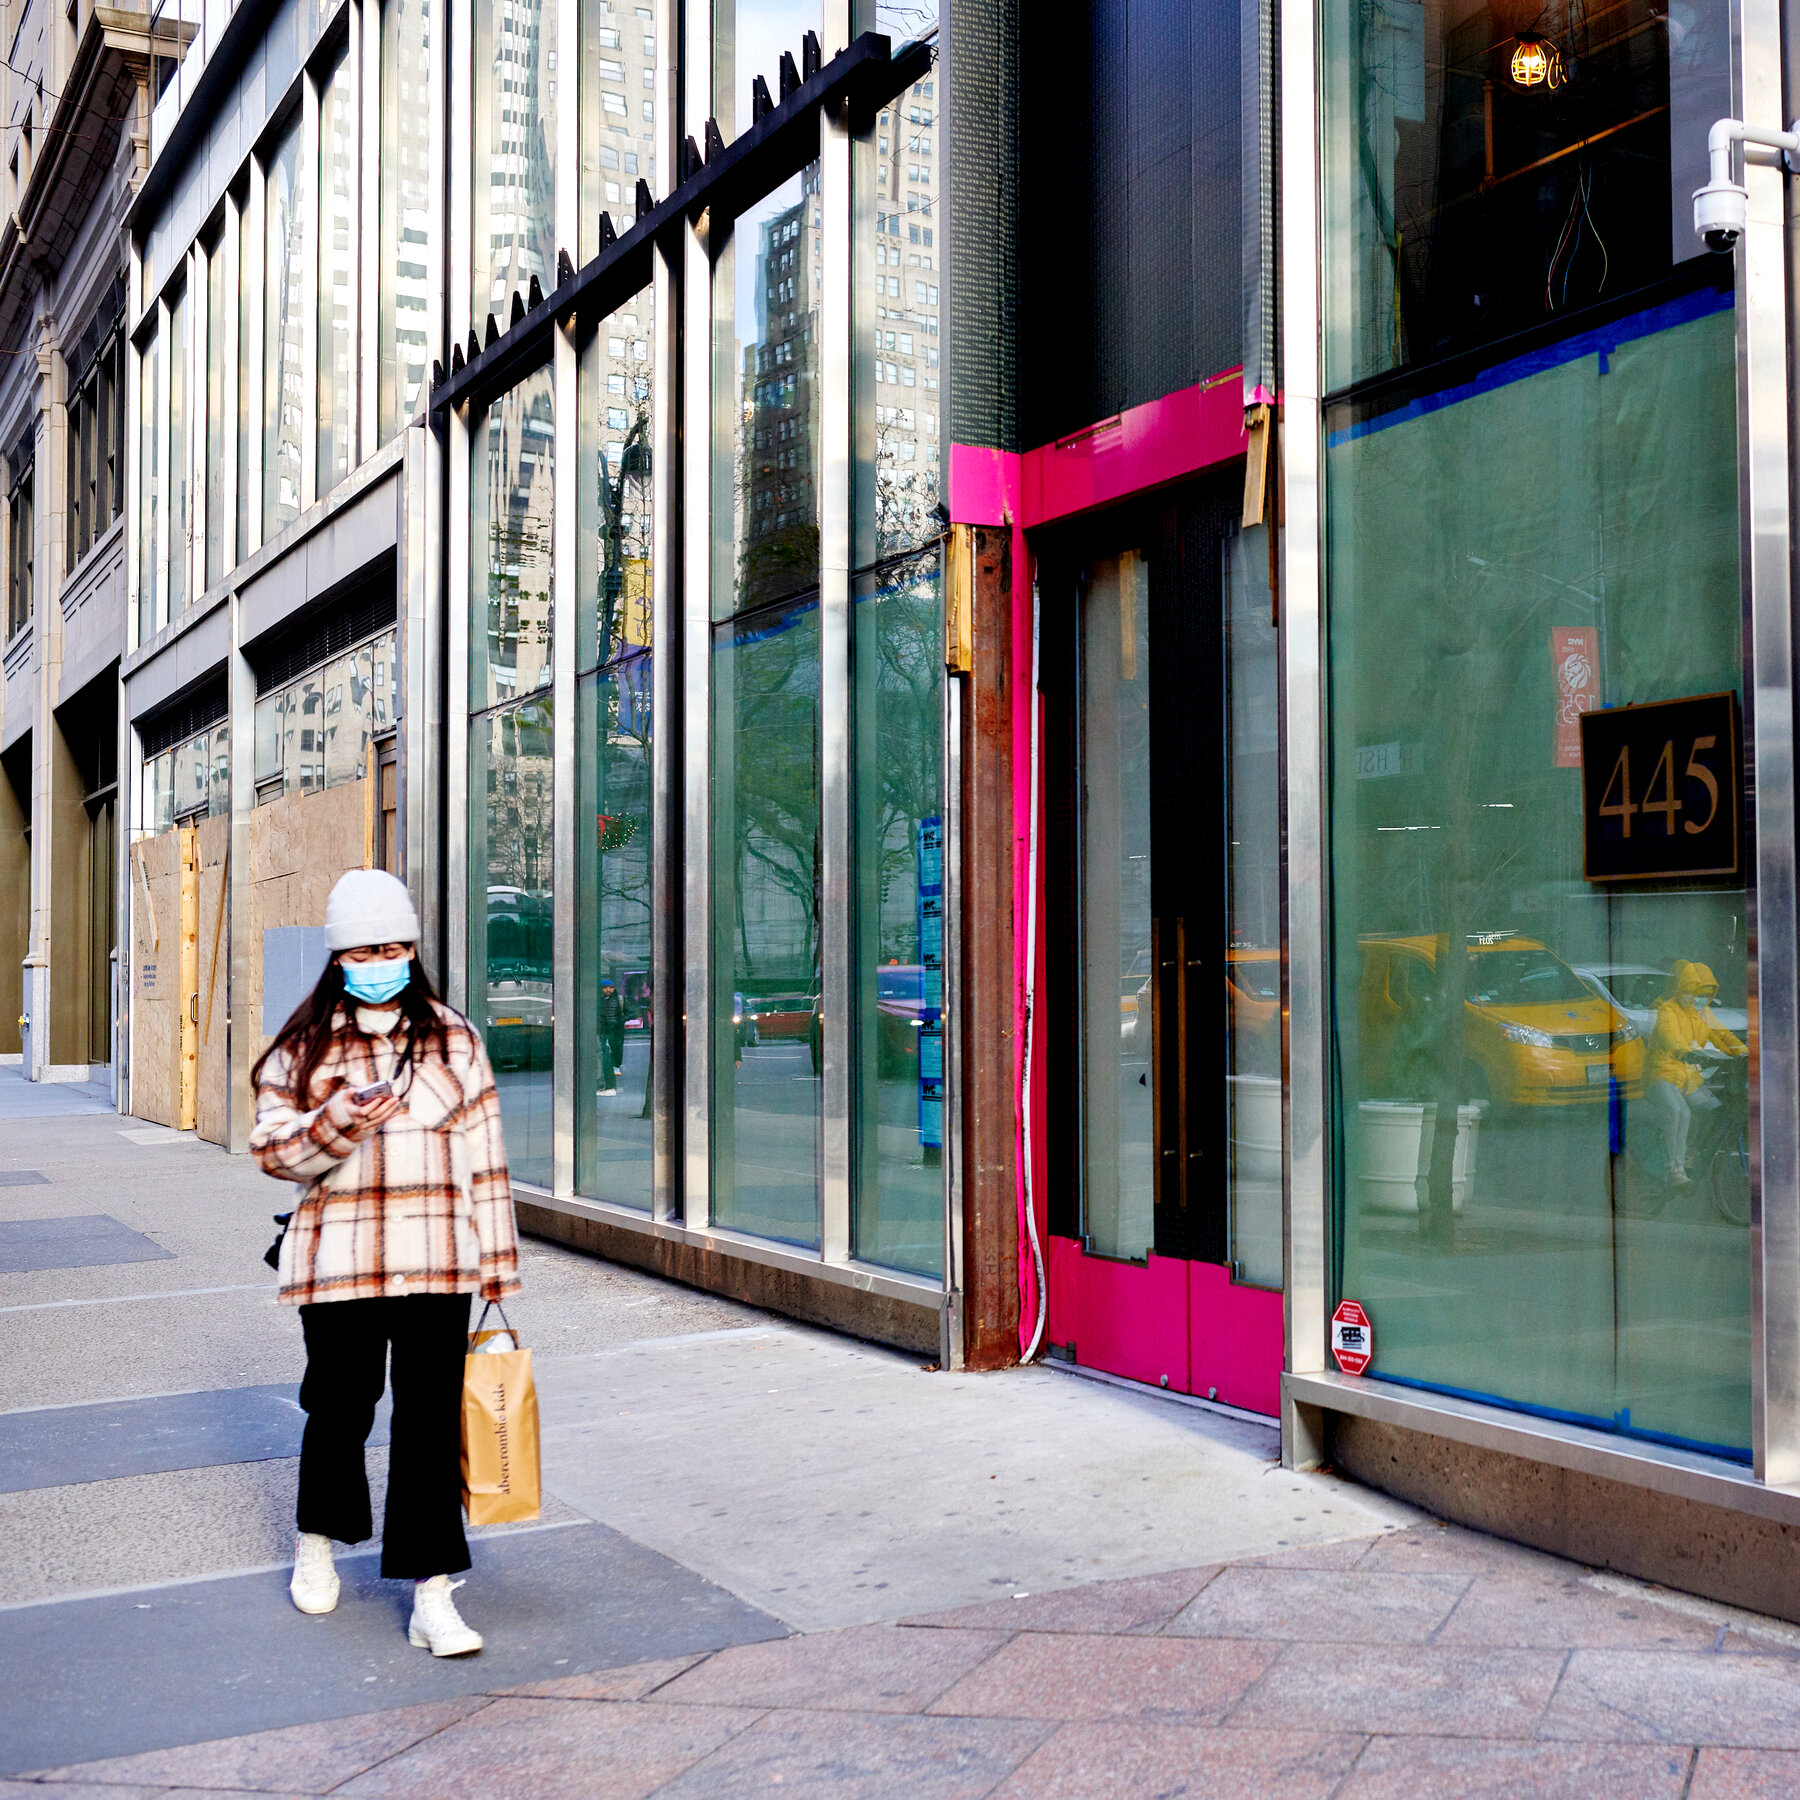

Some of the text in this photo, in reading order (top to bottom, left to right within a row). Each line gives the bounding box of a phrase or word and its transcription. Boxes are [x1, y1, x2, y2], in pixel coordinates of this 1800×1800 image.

[1598, 735, 1719, 839] 445
[492, 1383, 511, 1495] abercrombie kids
